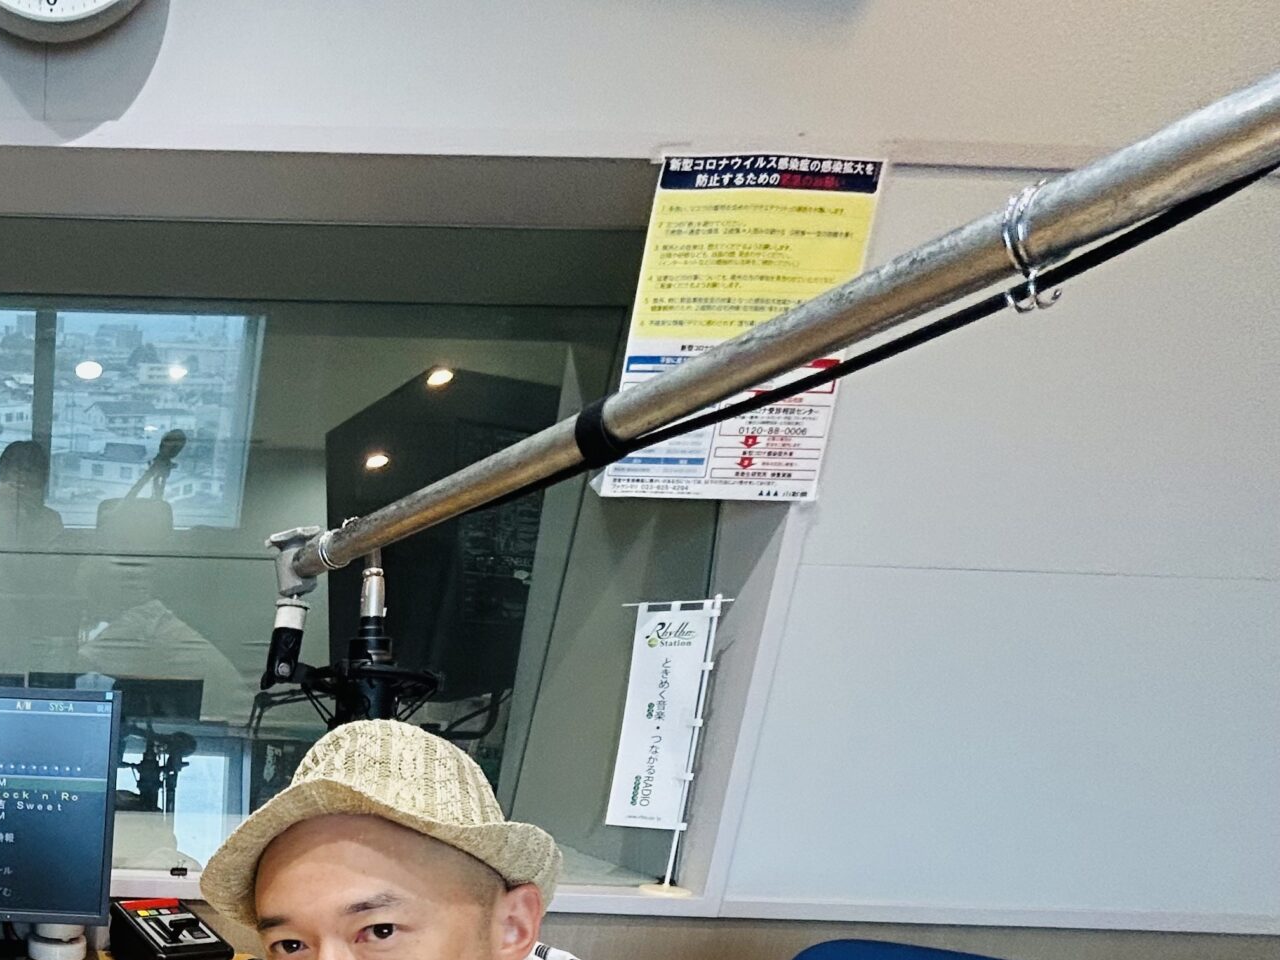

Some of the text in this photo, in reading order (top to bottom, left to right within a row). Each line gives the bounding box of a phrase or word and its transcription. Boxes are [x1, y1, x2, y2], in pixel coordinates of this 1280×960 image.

[669, 156, 874, 176] 新型コロナウイルス感染症の感染拡大を
[738, 426, 807, 436] 0120-88-0006
[660, 640, 692, 648] Station
[49, 703, 74, 712] SYS-A
[16, 801, 62, 811] Sweet
